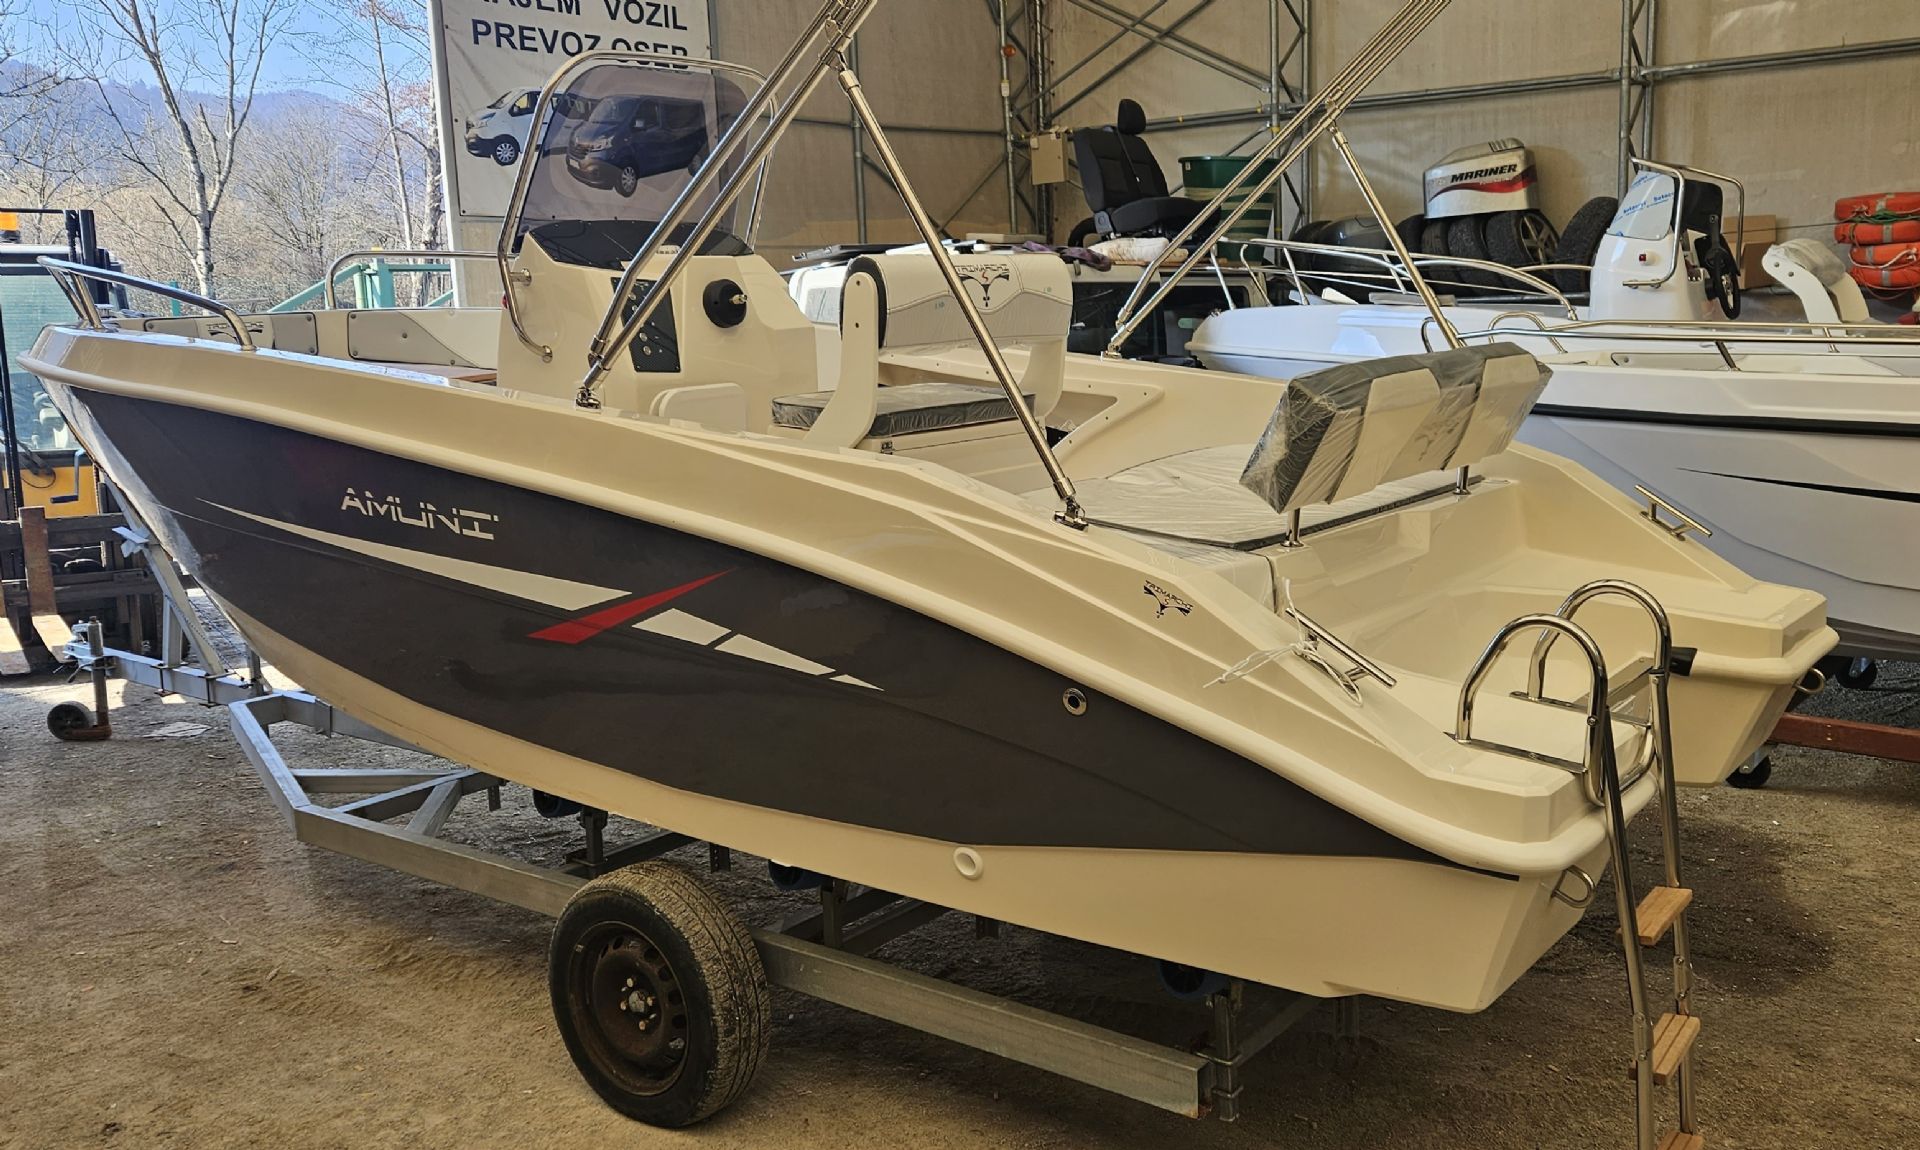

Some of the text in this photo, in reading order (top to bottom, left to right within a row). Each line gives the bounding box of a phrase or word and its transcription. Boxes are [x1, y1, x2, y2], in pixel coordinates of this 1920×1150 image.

[604, 0, 688, 31] VOZIL
[471, 18, 601, 57] PREVOZ
[1450, 163, 1518, 183] MARINER
